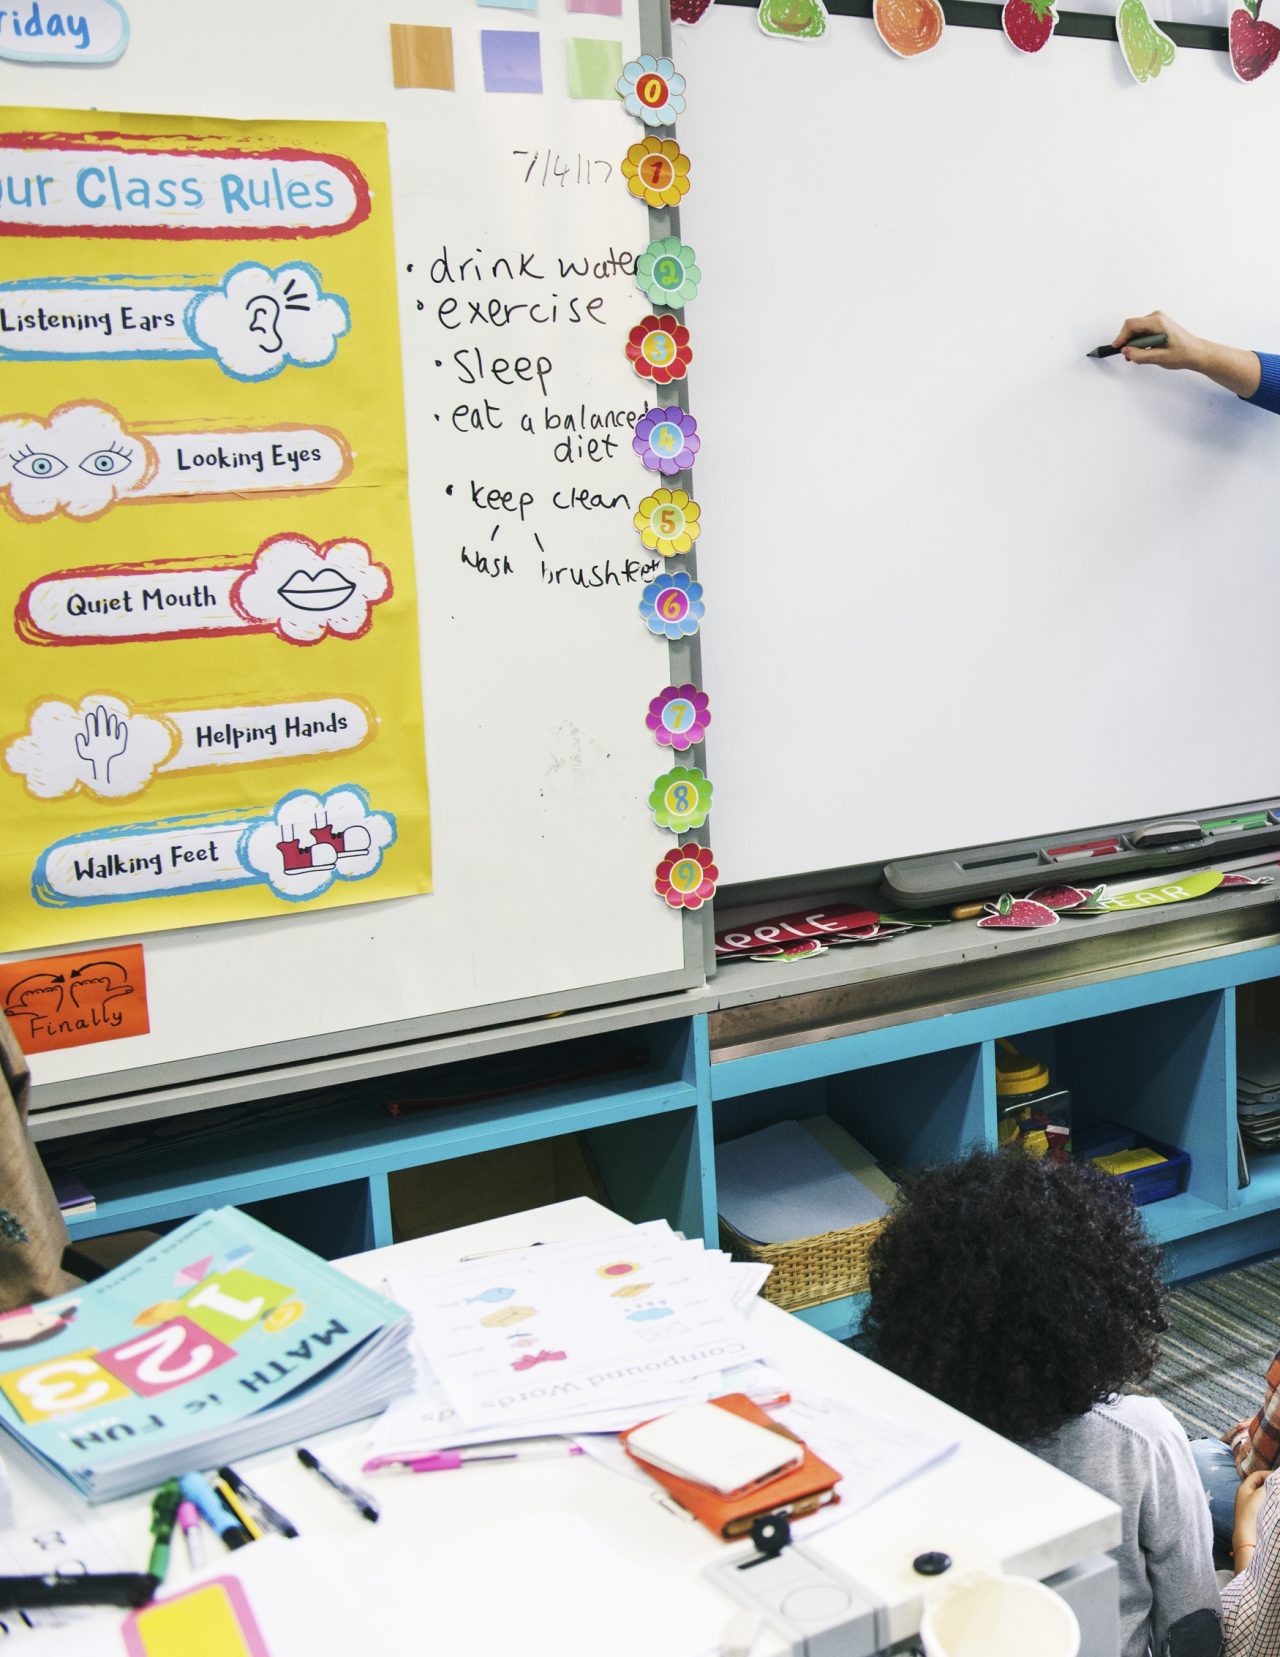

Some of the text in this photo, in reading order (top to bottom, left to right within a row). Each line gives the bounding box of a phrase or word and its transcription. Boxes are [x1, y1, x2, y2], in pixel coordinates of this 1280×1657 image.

[0, 1, 90, 49] riday
[644, 79, 661, 103] 0
[650, 161, 663, 184] 1
[0, 166, 334, 214] ur Class Rules
[430, 246, 640, 283] drink wate
[660, 259, 679, 285] 2
[1, 306, 175, 336] Listening Ears
[438, 294, 606, 329] exercise
[652, 335, 667, 361] 3
[452, 398, 502, 432] eat
[521, 414, 535, 434] a
[554, 434, 618, 463] diet
[658, 426, 675, 452] 4
[177, 444, 322, 472] Looking Eyes
[471, 480, 631, 521] keep clean
[660, 509, 676, 535] 5
[67, 585, 217, 617] Quiet Mouth
[663, 591, 680, 619] 6
[196, 712, 348, 749] Helping Hands
[669, 705, 687, 729] 7
[673, 785, 689, 812] 8
[74, 841, 219, 881] Walking Feet
[678, 863, 695, 890] 9
[715, 913, 848, 951] PPLE
[30, 1004, 123, 1038] Finally
[16, 1283, 266, 1412] 1 2 3
[238, 1318, 351, 1396] MATH
[480, 1343, 746, 1413] Compound Words
[69, 1413, 167, 1452] FUN
